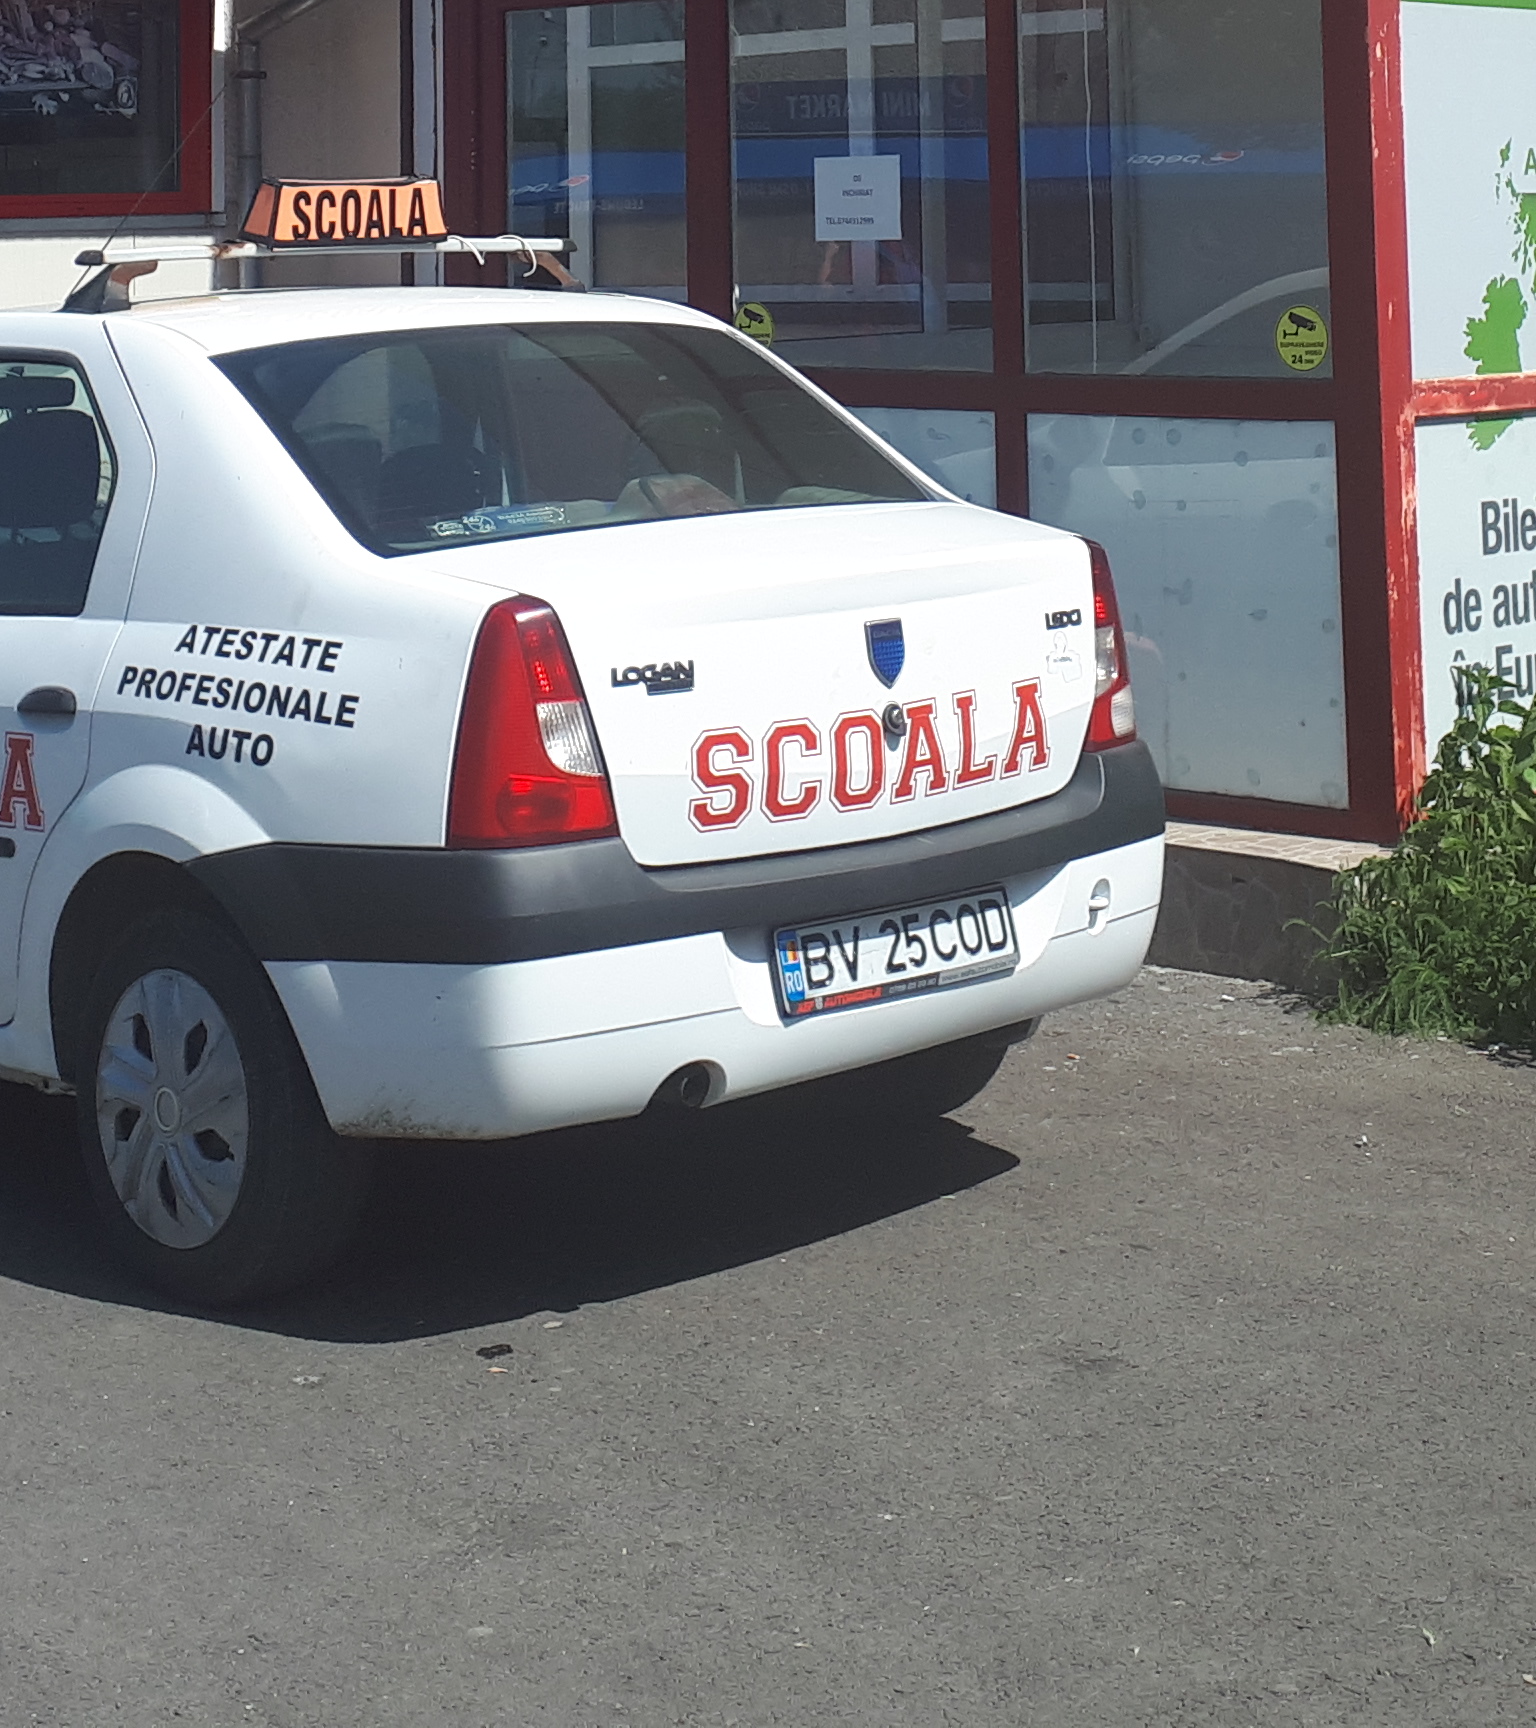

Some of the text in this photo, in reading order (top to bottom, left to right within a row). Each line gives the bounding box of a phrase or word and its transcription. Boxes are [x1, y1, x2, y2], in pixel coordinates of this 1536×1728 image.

[291, 187, 428, 240] SCOALA
[1291, 354, 1303, 364] 24
[1443, 577, 1483, 636] de
[174, 623, 343, 674] ATESTATE
[610, 659, 695, 689] LOGAN
[117, 666, 361, 730] PROFESIONALE
[185, 724, 275, 767] AUTO
[688, 677, 1052, 833] SCOALA
[785, 970, 804, 994] RO
[802, 924, 862, 989] BV
